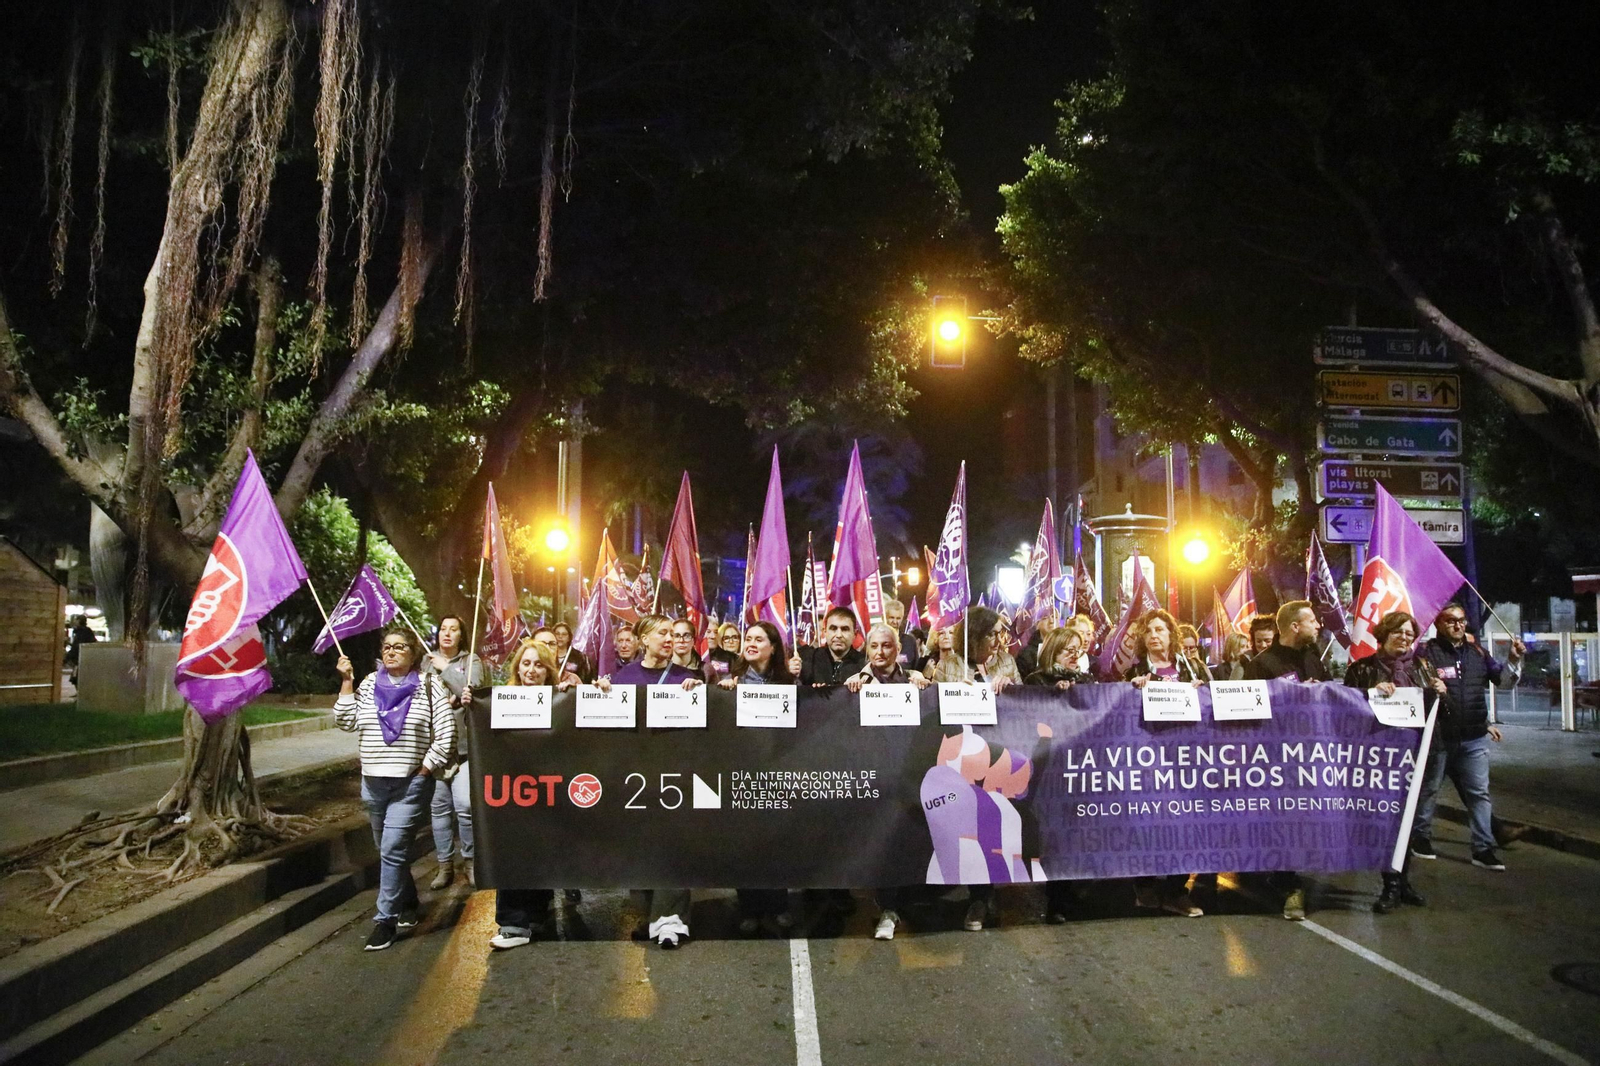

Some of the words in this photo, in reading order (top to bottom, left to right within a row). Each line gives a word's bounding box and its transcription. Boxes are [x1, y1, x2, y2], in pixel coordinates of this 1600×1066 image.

[1324, 333, 1363, 344] urcia
[1327, 434, 1358, 445] Cabo
[1365, 436, 1380, 446] de
[1386, 436, 1415, 448] Gata
[1355, 467, 1392, 478] litoral
[1329, 477, 1369, 491] playas
[582, 691, 602, 699] Laura
[652, 691, 669, 699] Laila
[742, 691, 759, 699] Sara
[1066, 748, 1097, 770] LA
[1105, 744, 1271, 767] VIOLENCIA
[1282, 742, 1416, 769] MACHISTA
[731, 770, 752, 781] DÍA
[756, 770, 857, 781] INTERNACIONAL
[860, 770, 877, 780] DE
[1063, 770, 1143, 794] TIENE
[1155, 766, 1284, 790] MUCHOS
[1299, 766, 1414, 791] NOMBRES
[731, 781, 746, 790] LA
[750, 779, 831, 790] ELIMINACIÓN
[835, 780, 852, 789] DE
[855, 780, 871, 789] LA
[484, 775, 563, 808] UGT
[731, 790, 797, 800] VIOLENCIA
[801, 789, 853, 800] CONTRA
[856, 789, 880, 799] LAS
[731, 799, 793, 809] MUJERES.
[925, 795, 946, 811] UGT
[1076, 801, 1122, 818] SOLO
[1128, 801, 1162, 816] HAY
[1168, 800, 1205, 816] QUE
[1211, 798, 1271, 813] SABER
